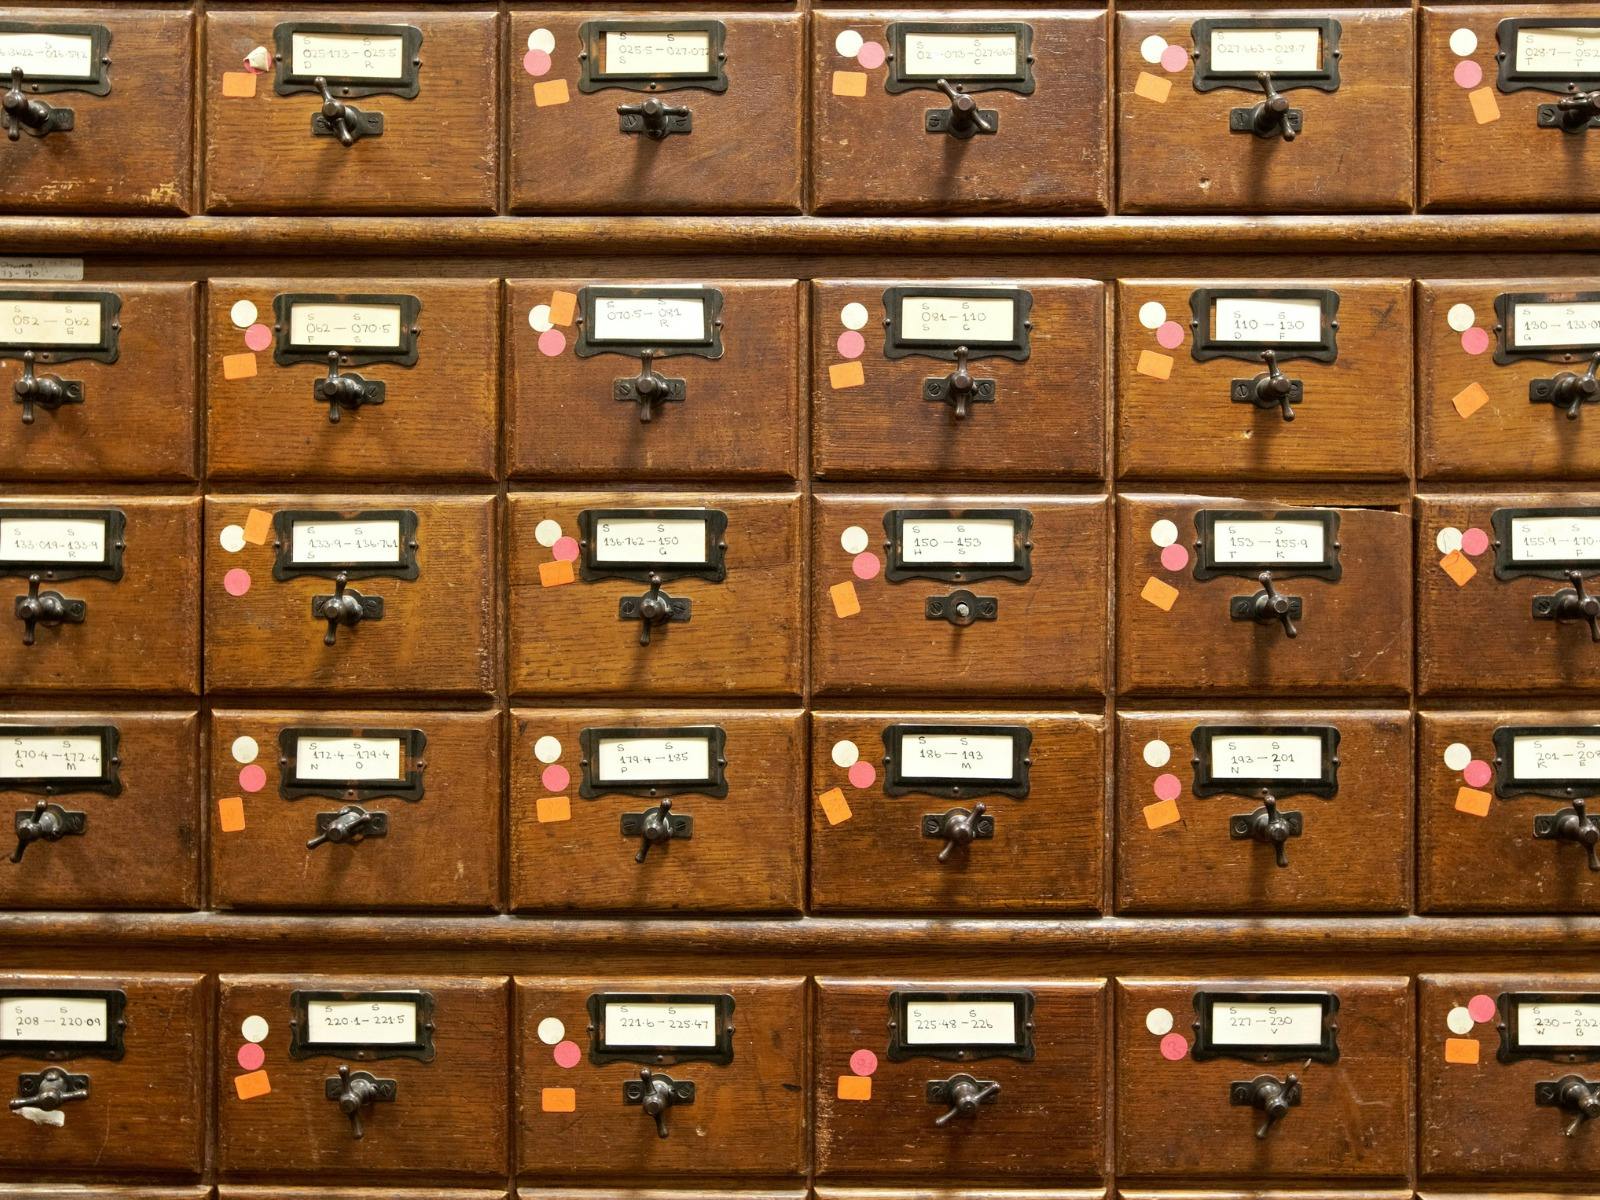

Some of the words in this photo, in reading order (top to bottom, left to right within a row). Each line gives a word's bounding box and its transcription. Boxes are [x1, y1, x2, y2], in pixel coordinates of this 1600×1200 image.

[12, 315, 40, 326] 052
[64, 316, 90, 327] 062
[921, 311, 947, 322] 081
[962, 312, 987, 322] 110
[306, 322, 331, 333] 062
[1234, 319, 1258, 330] 110
[1279, 320, 1305, 330] 130
[1525, 320, 1548, 331] 130
[658, 536, 679, 546] 150
[914, 537, 939, 548] 150
[957, 537, 982, 547] 153
[1230, 537, 1254, 547] 153
[667, 751, 689, 763] 185
[919, 748, 942, 759] 186
[961, 750, 984, 761] 193
[1230, 755, 1254, 765] 193
[1271, 753, 1295, 763] 201
[15, 1016, 40, 1026] 208
[970, 1018, 994, 1029] 226
[1229, 1017, 1252, 1027] 227
[1269, 1016, 1294, 1026] 230
[1535, 1017, 1560, 1027] 230
